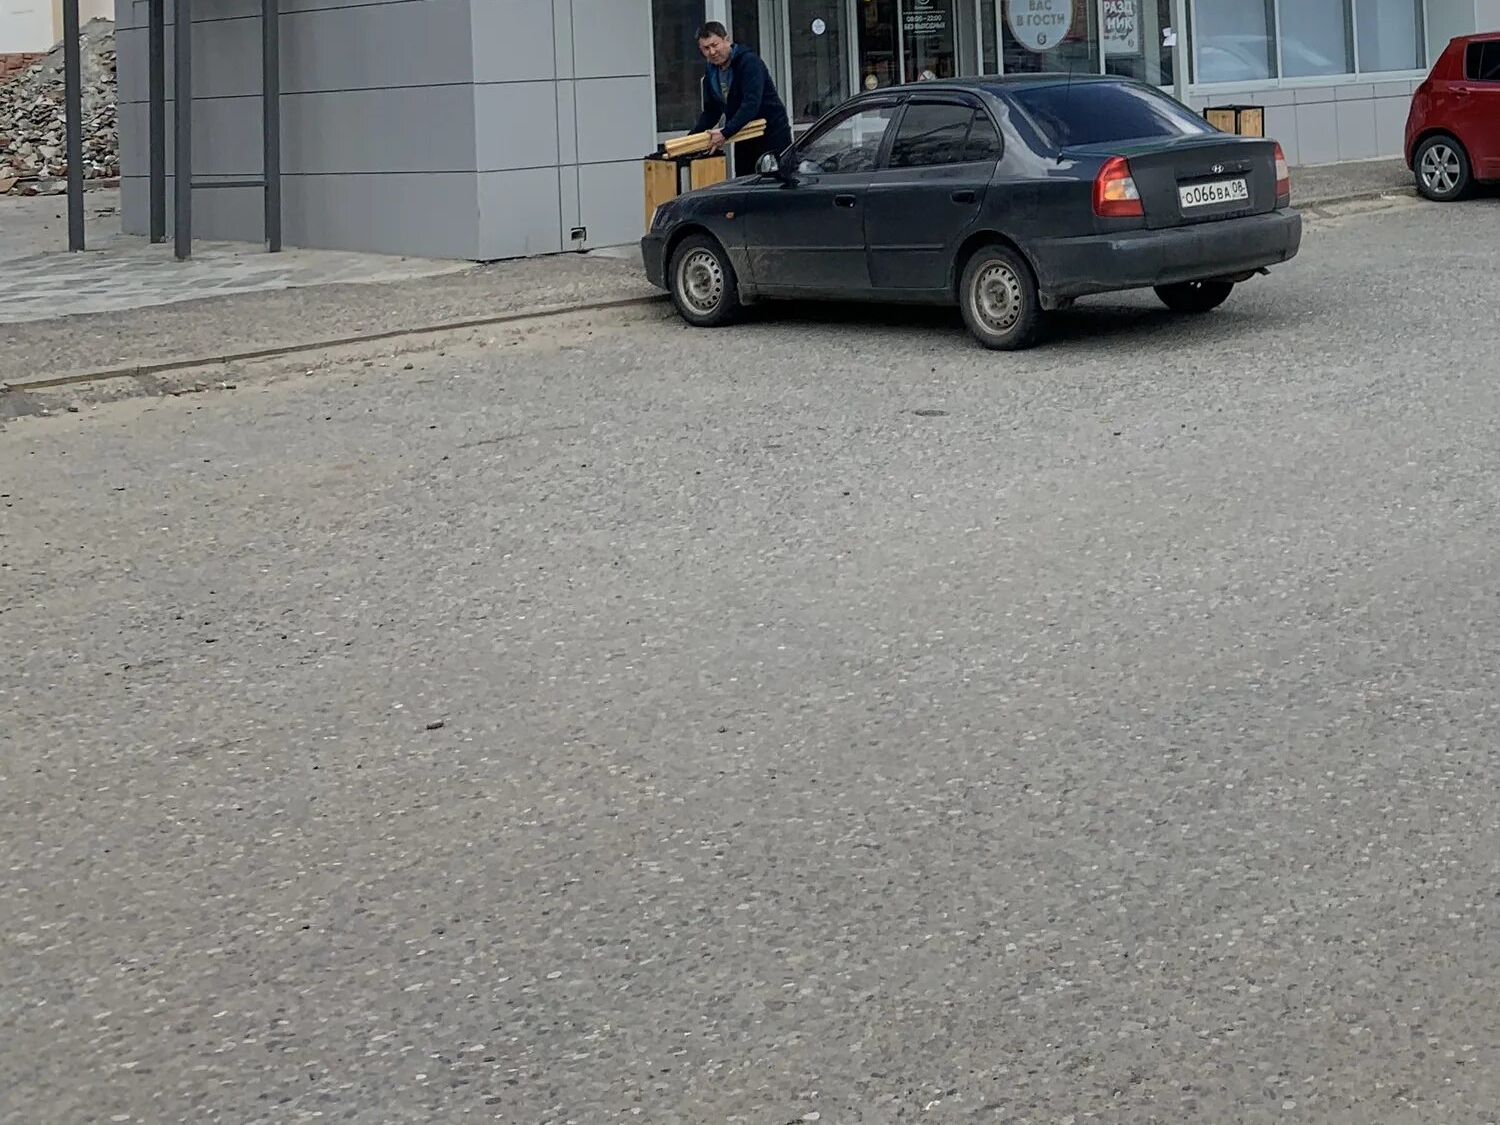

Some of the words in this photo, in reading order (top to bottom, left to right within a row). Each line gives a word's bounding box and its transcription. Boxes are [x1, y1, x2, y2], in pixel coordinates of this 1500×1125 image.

[1029, 0, 1052, 11] ВАС
[1103, 0, 1133, 15] РАЗД
[1017, 15, 1024, 26] В
[1026, 13, 1065, 26] ГОСТИ
[1106, 17, 1133, 29] НИК
